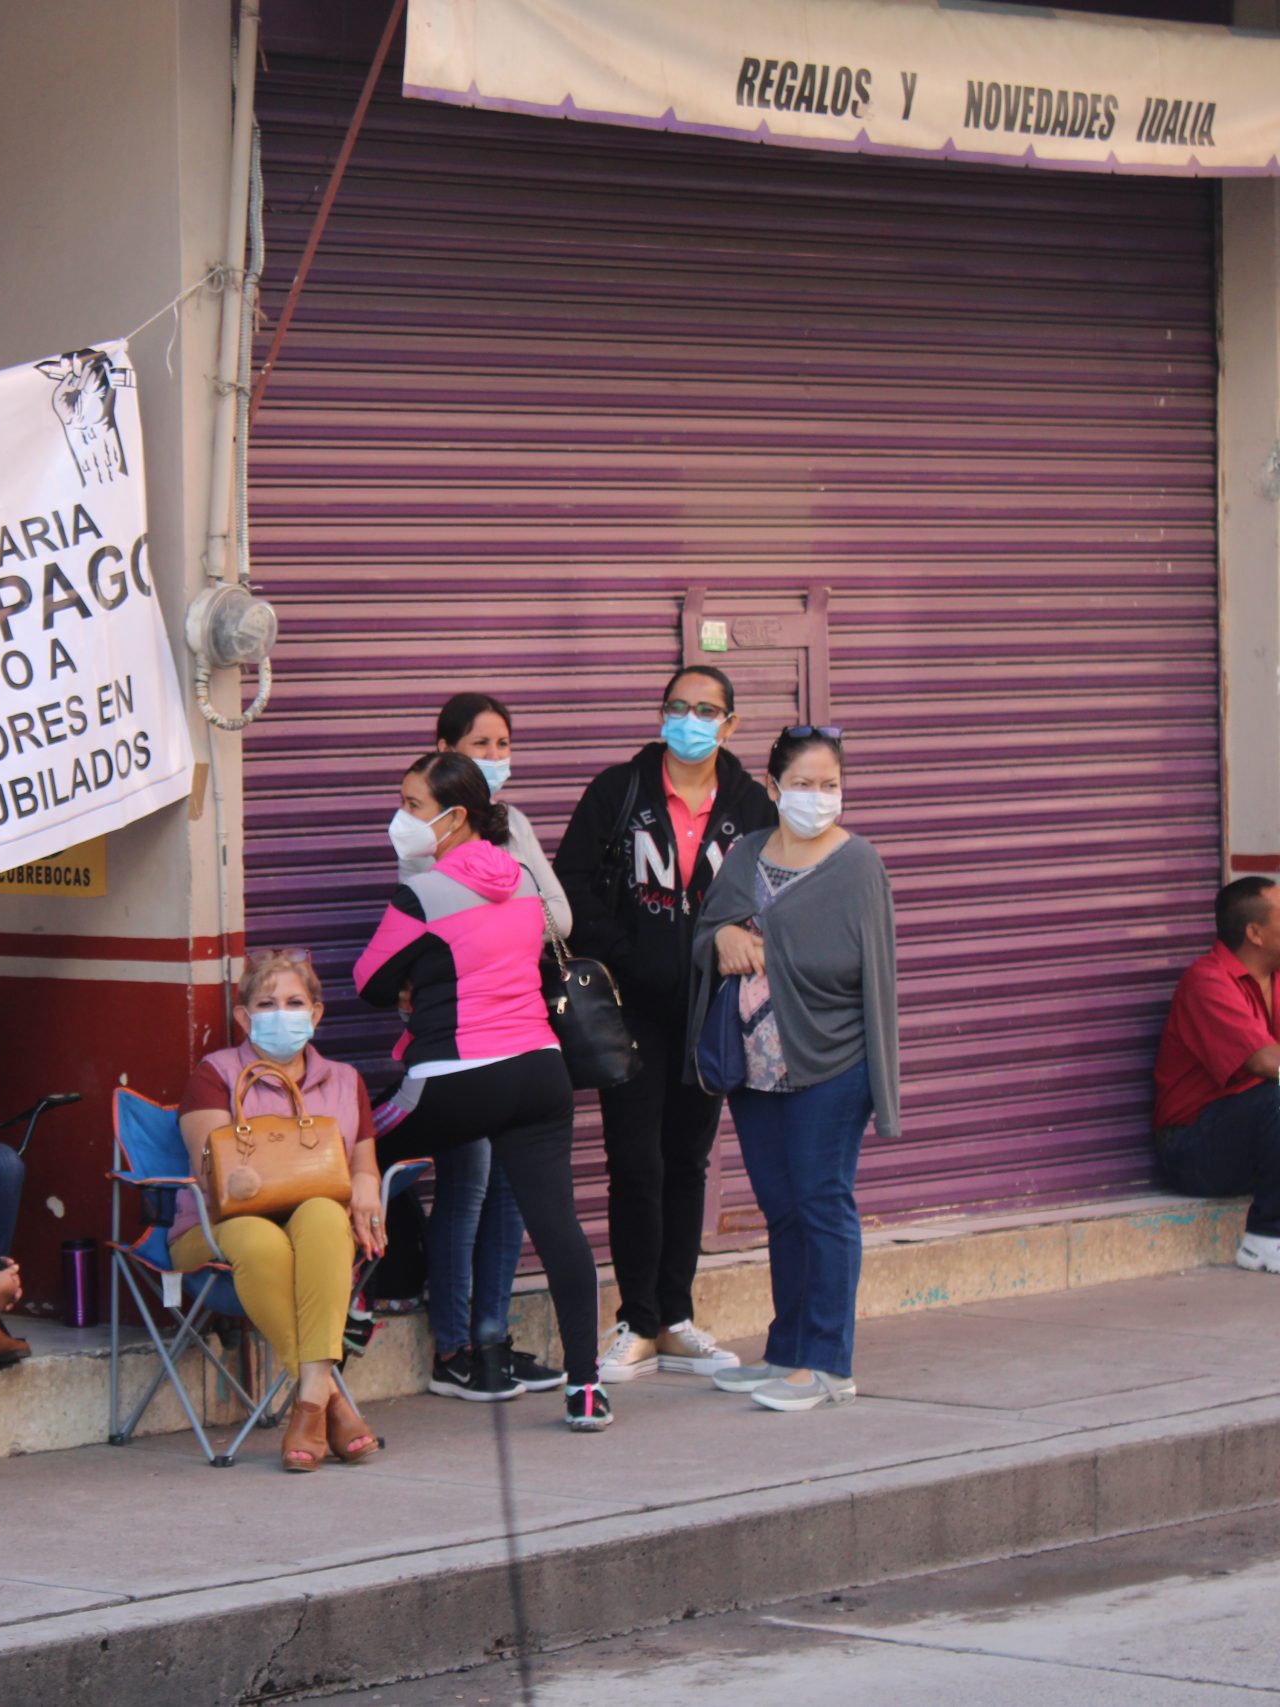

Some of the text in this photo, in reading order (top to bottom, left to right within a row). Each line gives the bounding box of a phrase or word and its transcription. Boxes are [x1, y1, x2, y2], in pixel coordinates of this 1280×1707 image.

[736, 57, 1216, 147] REGALOS Y NOVEDADES IDALIA
[50, 638, 76, 681] A
[98, 675, 135, 727] EN
